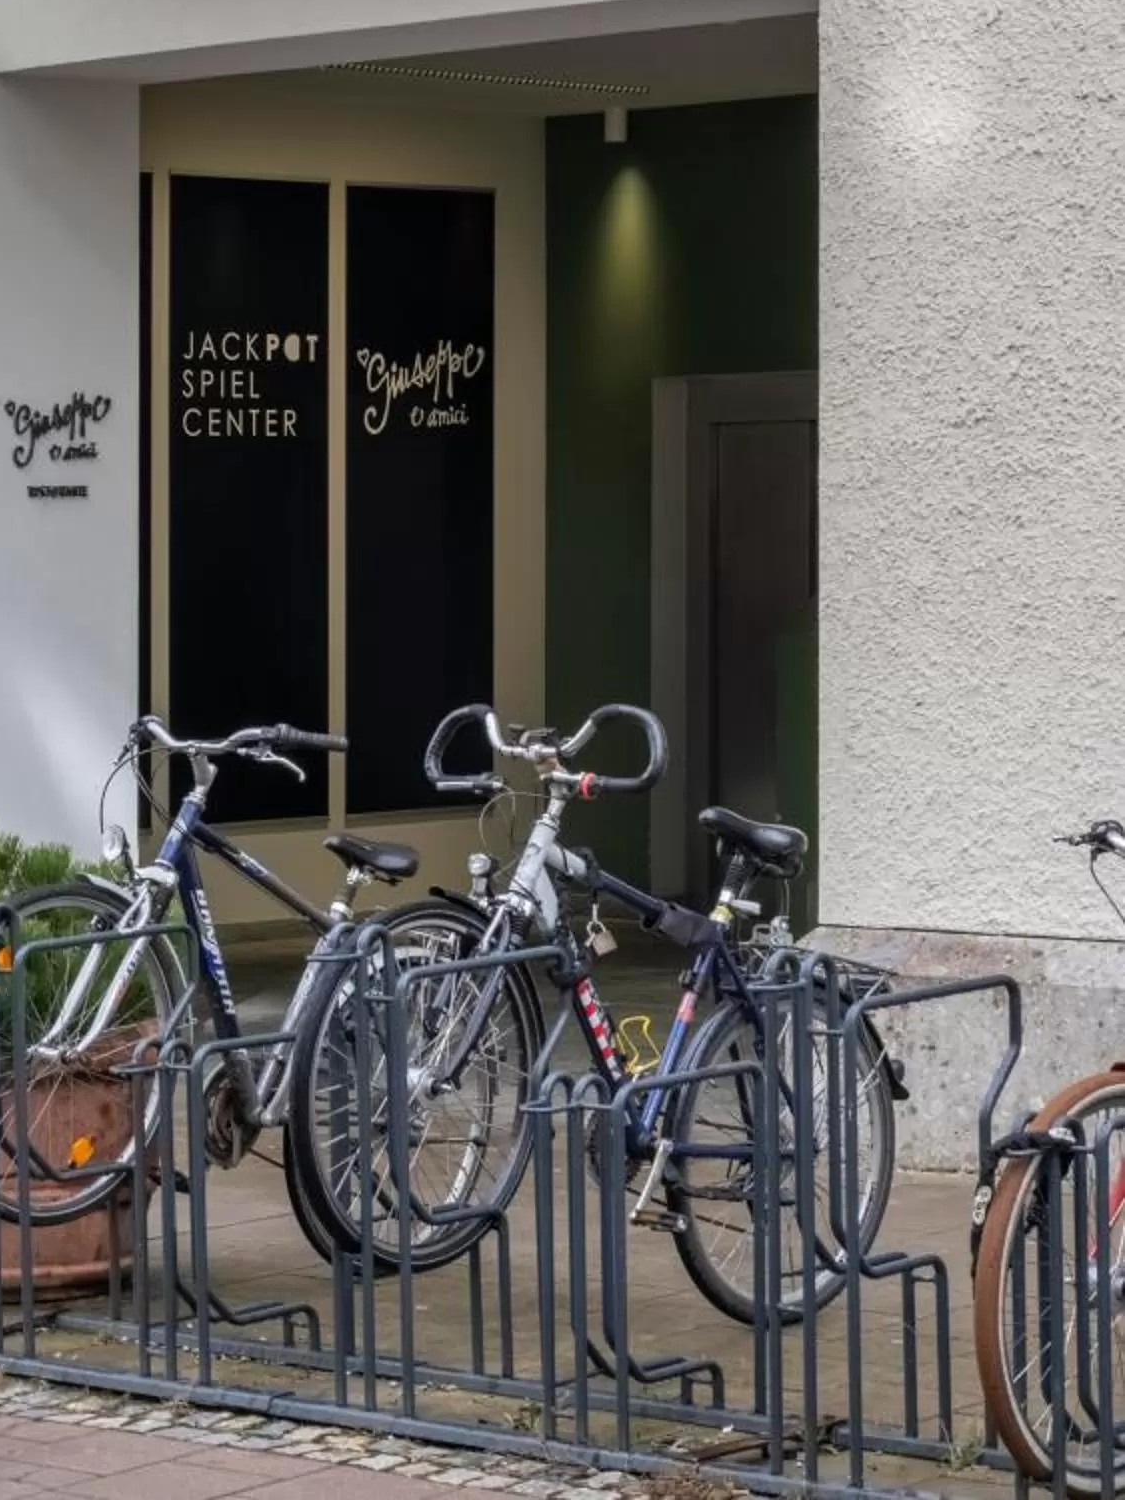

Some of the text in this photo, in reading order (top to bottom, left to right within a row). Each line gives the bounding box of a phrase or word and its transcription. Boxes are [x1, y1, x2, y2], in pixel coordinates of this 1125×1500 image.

[182, 331, 319, 362] JACKPOT
[182, 368, 261, 399] SPIEL
[364, 339, 486, 435] Giuseppe
[182, 407, 298, 437] CENTER
[426, 402, 470, 428] amici
